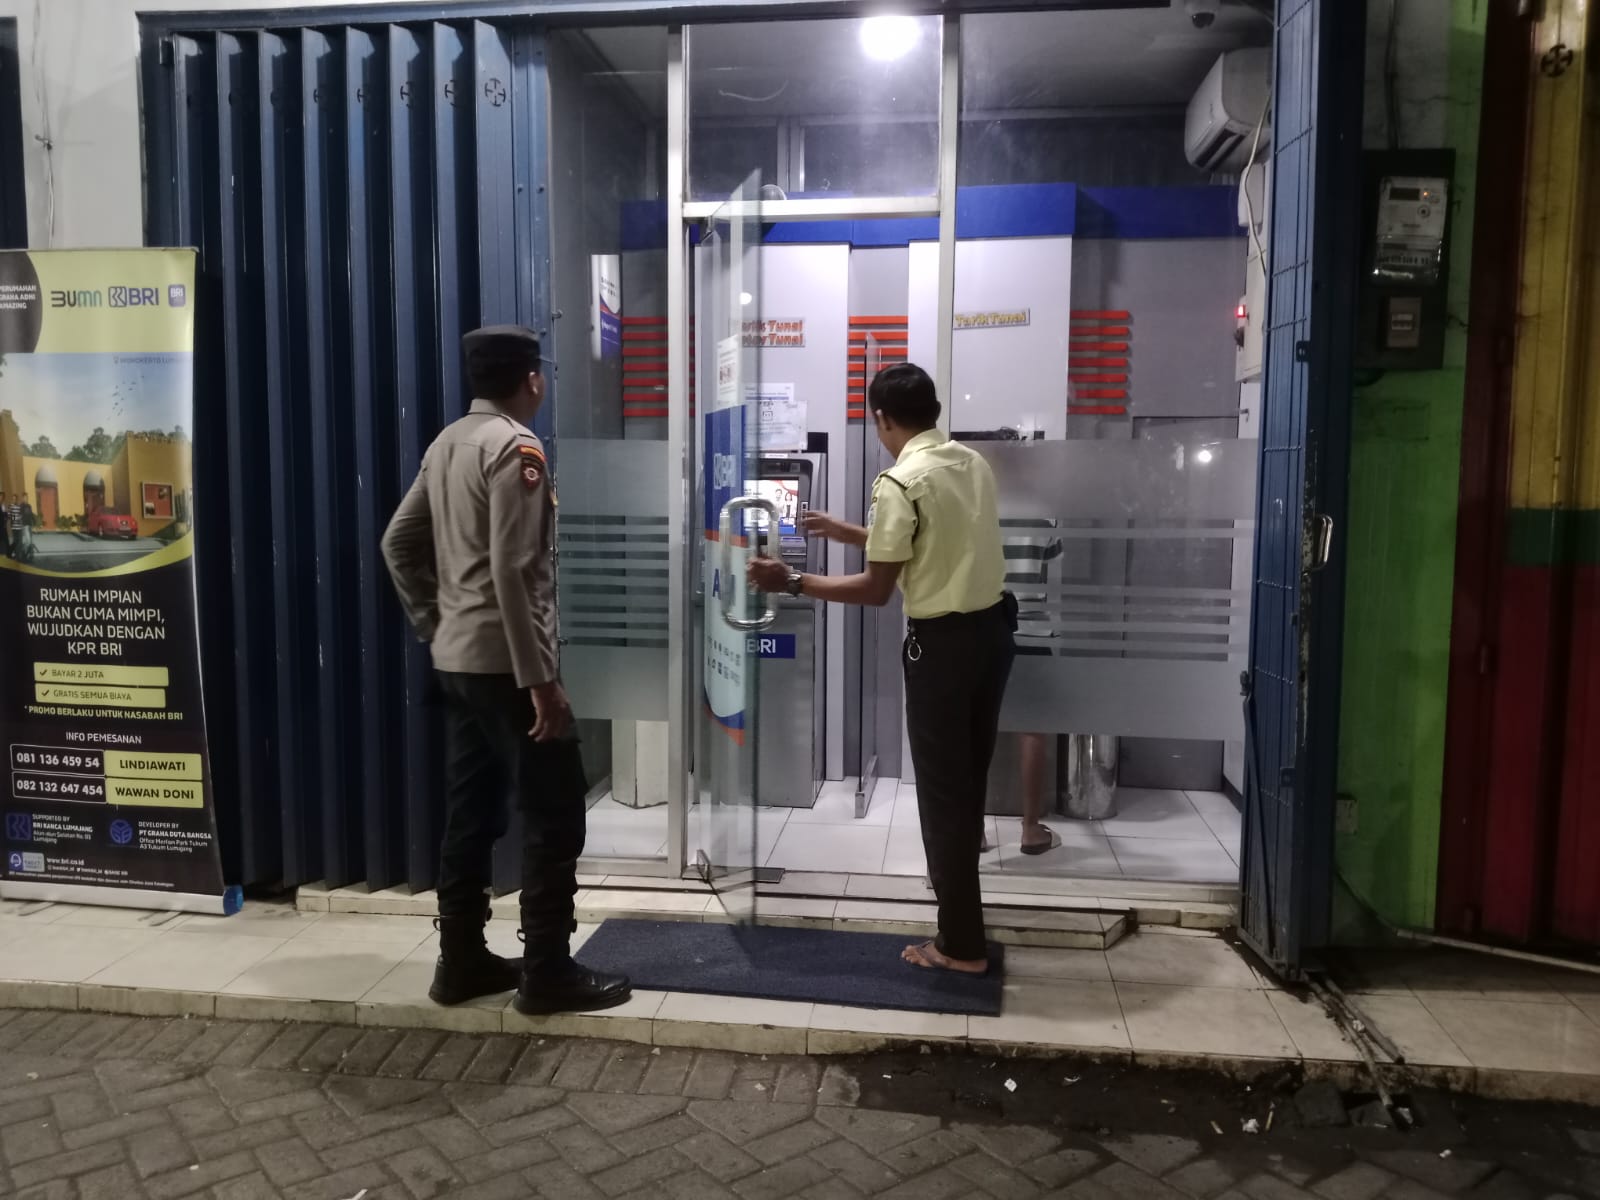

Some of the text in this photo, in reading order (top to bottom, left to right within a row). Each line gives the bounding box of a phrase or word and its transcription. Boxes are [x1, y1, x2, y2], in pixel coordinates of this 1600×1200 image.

[129, 287, 160, 306] BRI
[170, 287, 184, 297] BRI
[767, 319, 803, 332] Tunai
[768, 333, 803, 346] Tunai
[40, 588, 142, 604] RUMAH IMPIAN
[26, 605, 165, 624] BUKAN CUMA MIMPI,
[28, 622, 165, 639] WUJUDKAN DENGAN
[68, 642, 122, 656] KPR BRI
[746, 638, 776, 654] BRI
[51, 670, 104, 679] BAYAR 2 JUTA
[53, 689, 132, 701] GRATIS SEMUA BIAYA
[28, 706, 183, 720] PROMO BERLAKU UNTUK NASABAH BRI
[66, 732, 142, 744] INFO PEMESANAN
[16, 753, 100, 768] 081 136 459 54
[119, 759, 186, 771] LINDIAWATI
[16, 780, 103, 795] 082 132 647 454
[115, 787, 194, 799] WAWAN DONI
[63, 824, 93, 833] LUMAJANG
[138, 821, 170, 829] DEVELOPER
